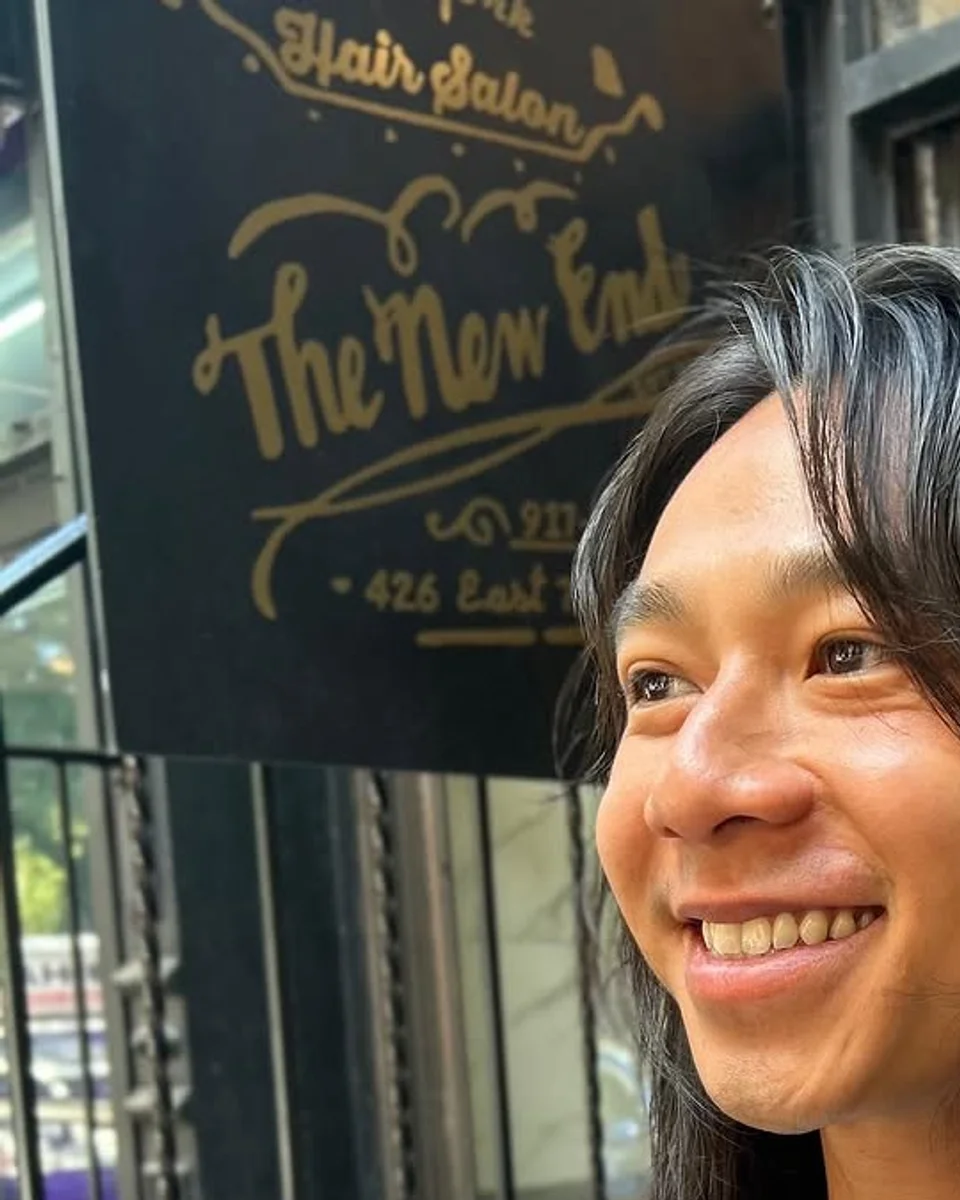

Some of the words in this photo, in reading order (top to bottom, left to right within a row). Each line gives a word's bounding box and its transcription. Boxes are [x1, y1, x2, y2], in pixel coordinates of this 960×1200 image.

[274, 7, 425, 95] Hair
[430, 42, 585, 144] Salon
[193, 263, 385, 460] The
[362, 284, 549, 420] New
[364, 568, 442, 613] 426
[456, 564, 546, 613] East
